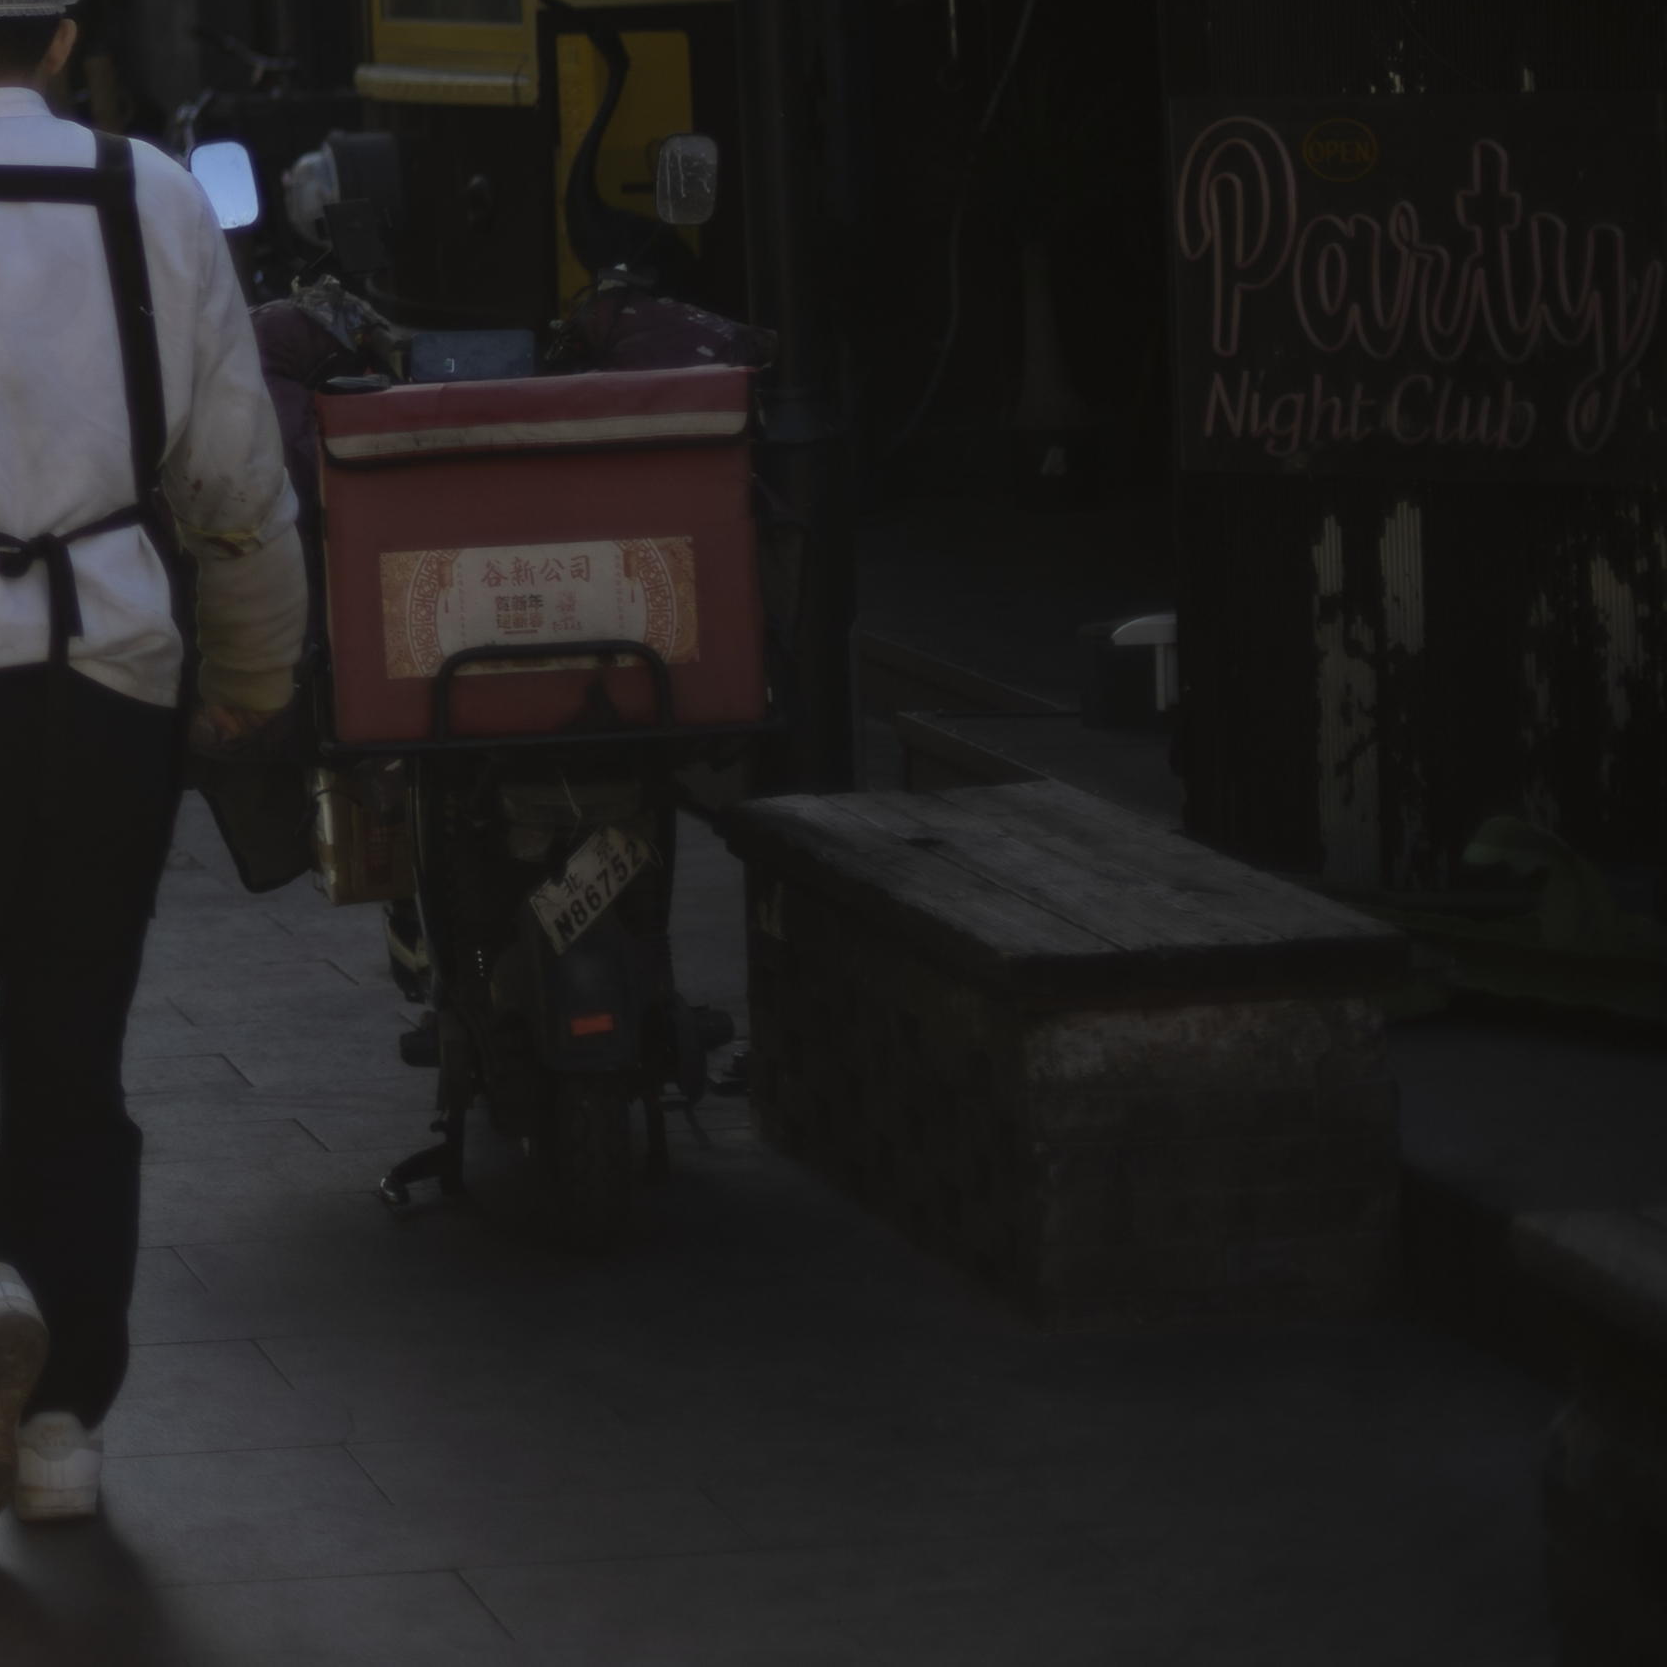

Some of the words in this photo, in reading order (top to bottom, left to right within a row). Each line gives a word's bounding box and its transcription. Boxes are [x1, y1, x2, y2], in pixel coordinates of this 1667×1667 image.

[1308, 141, 1372, 164] OPEN
[1177, 114, 1665, 455] Party
[1203, 371, 1376, 457] Night
[1385, 374, 1537, 450] Club
